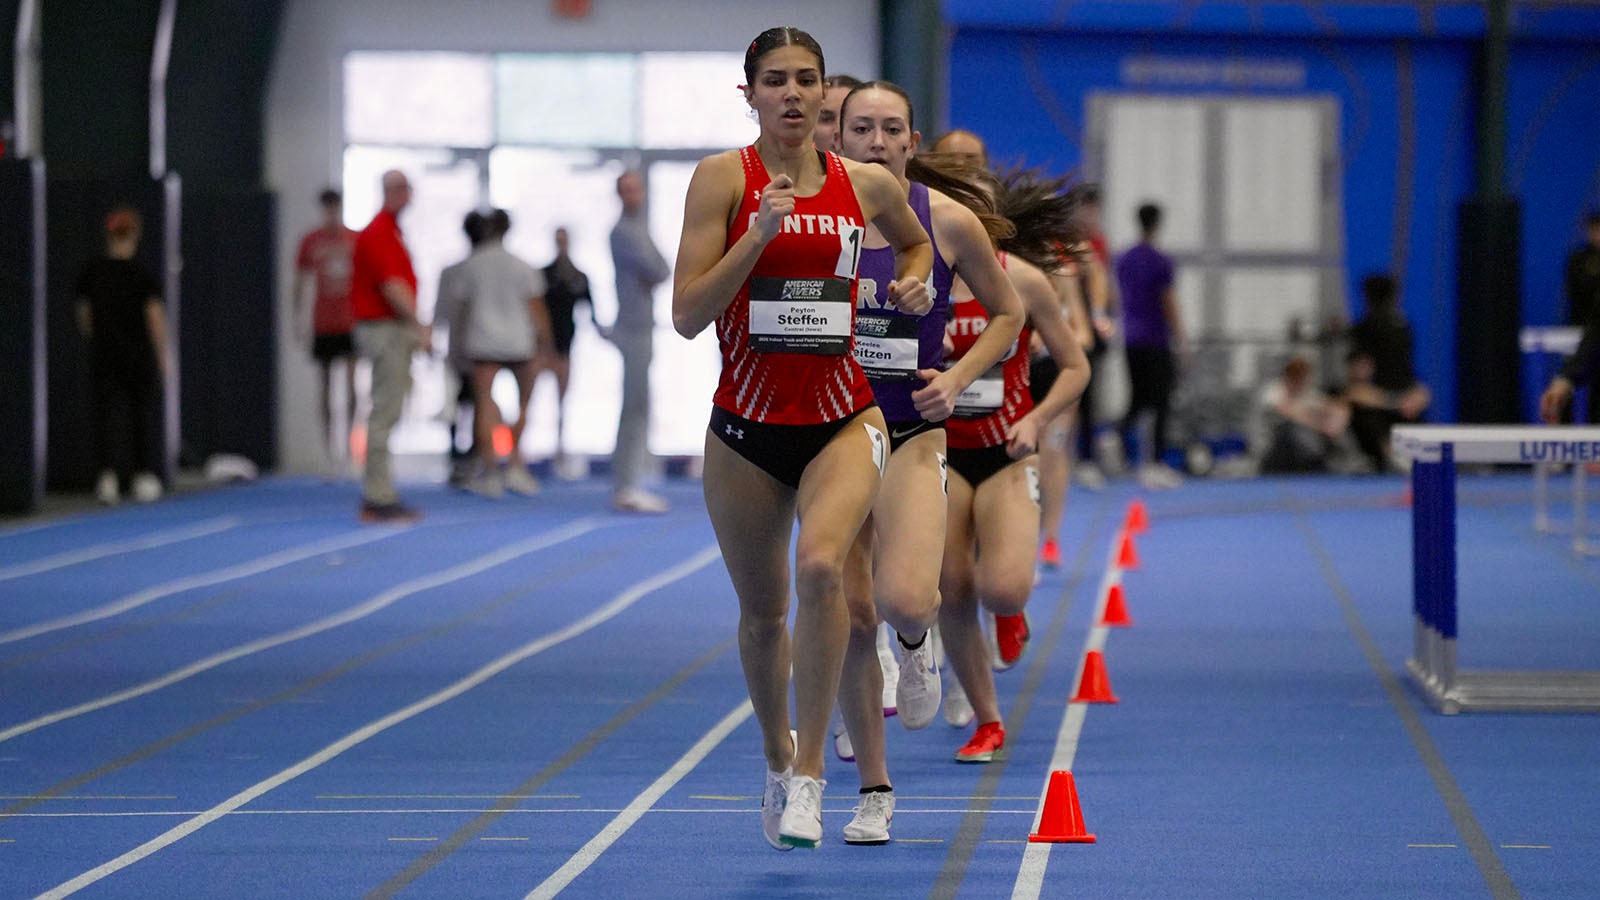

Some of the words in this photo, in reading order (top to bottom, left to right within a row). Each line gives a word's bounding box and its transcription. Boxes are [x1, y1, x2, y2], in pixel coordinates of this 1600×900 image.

[849, 229, 859, 275] 1
[784, 280, 824, 288] AMERICAN
[777, 314, 828, 325] Steffen
[854, 348, 892, 360] eitzen
